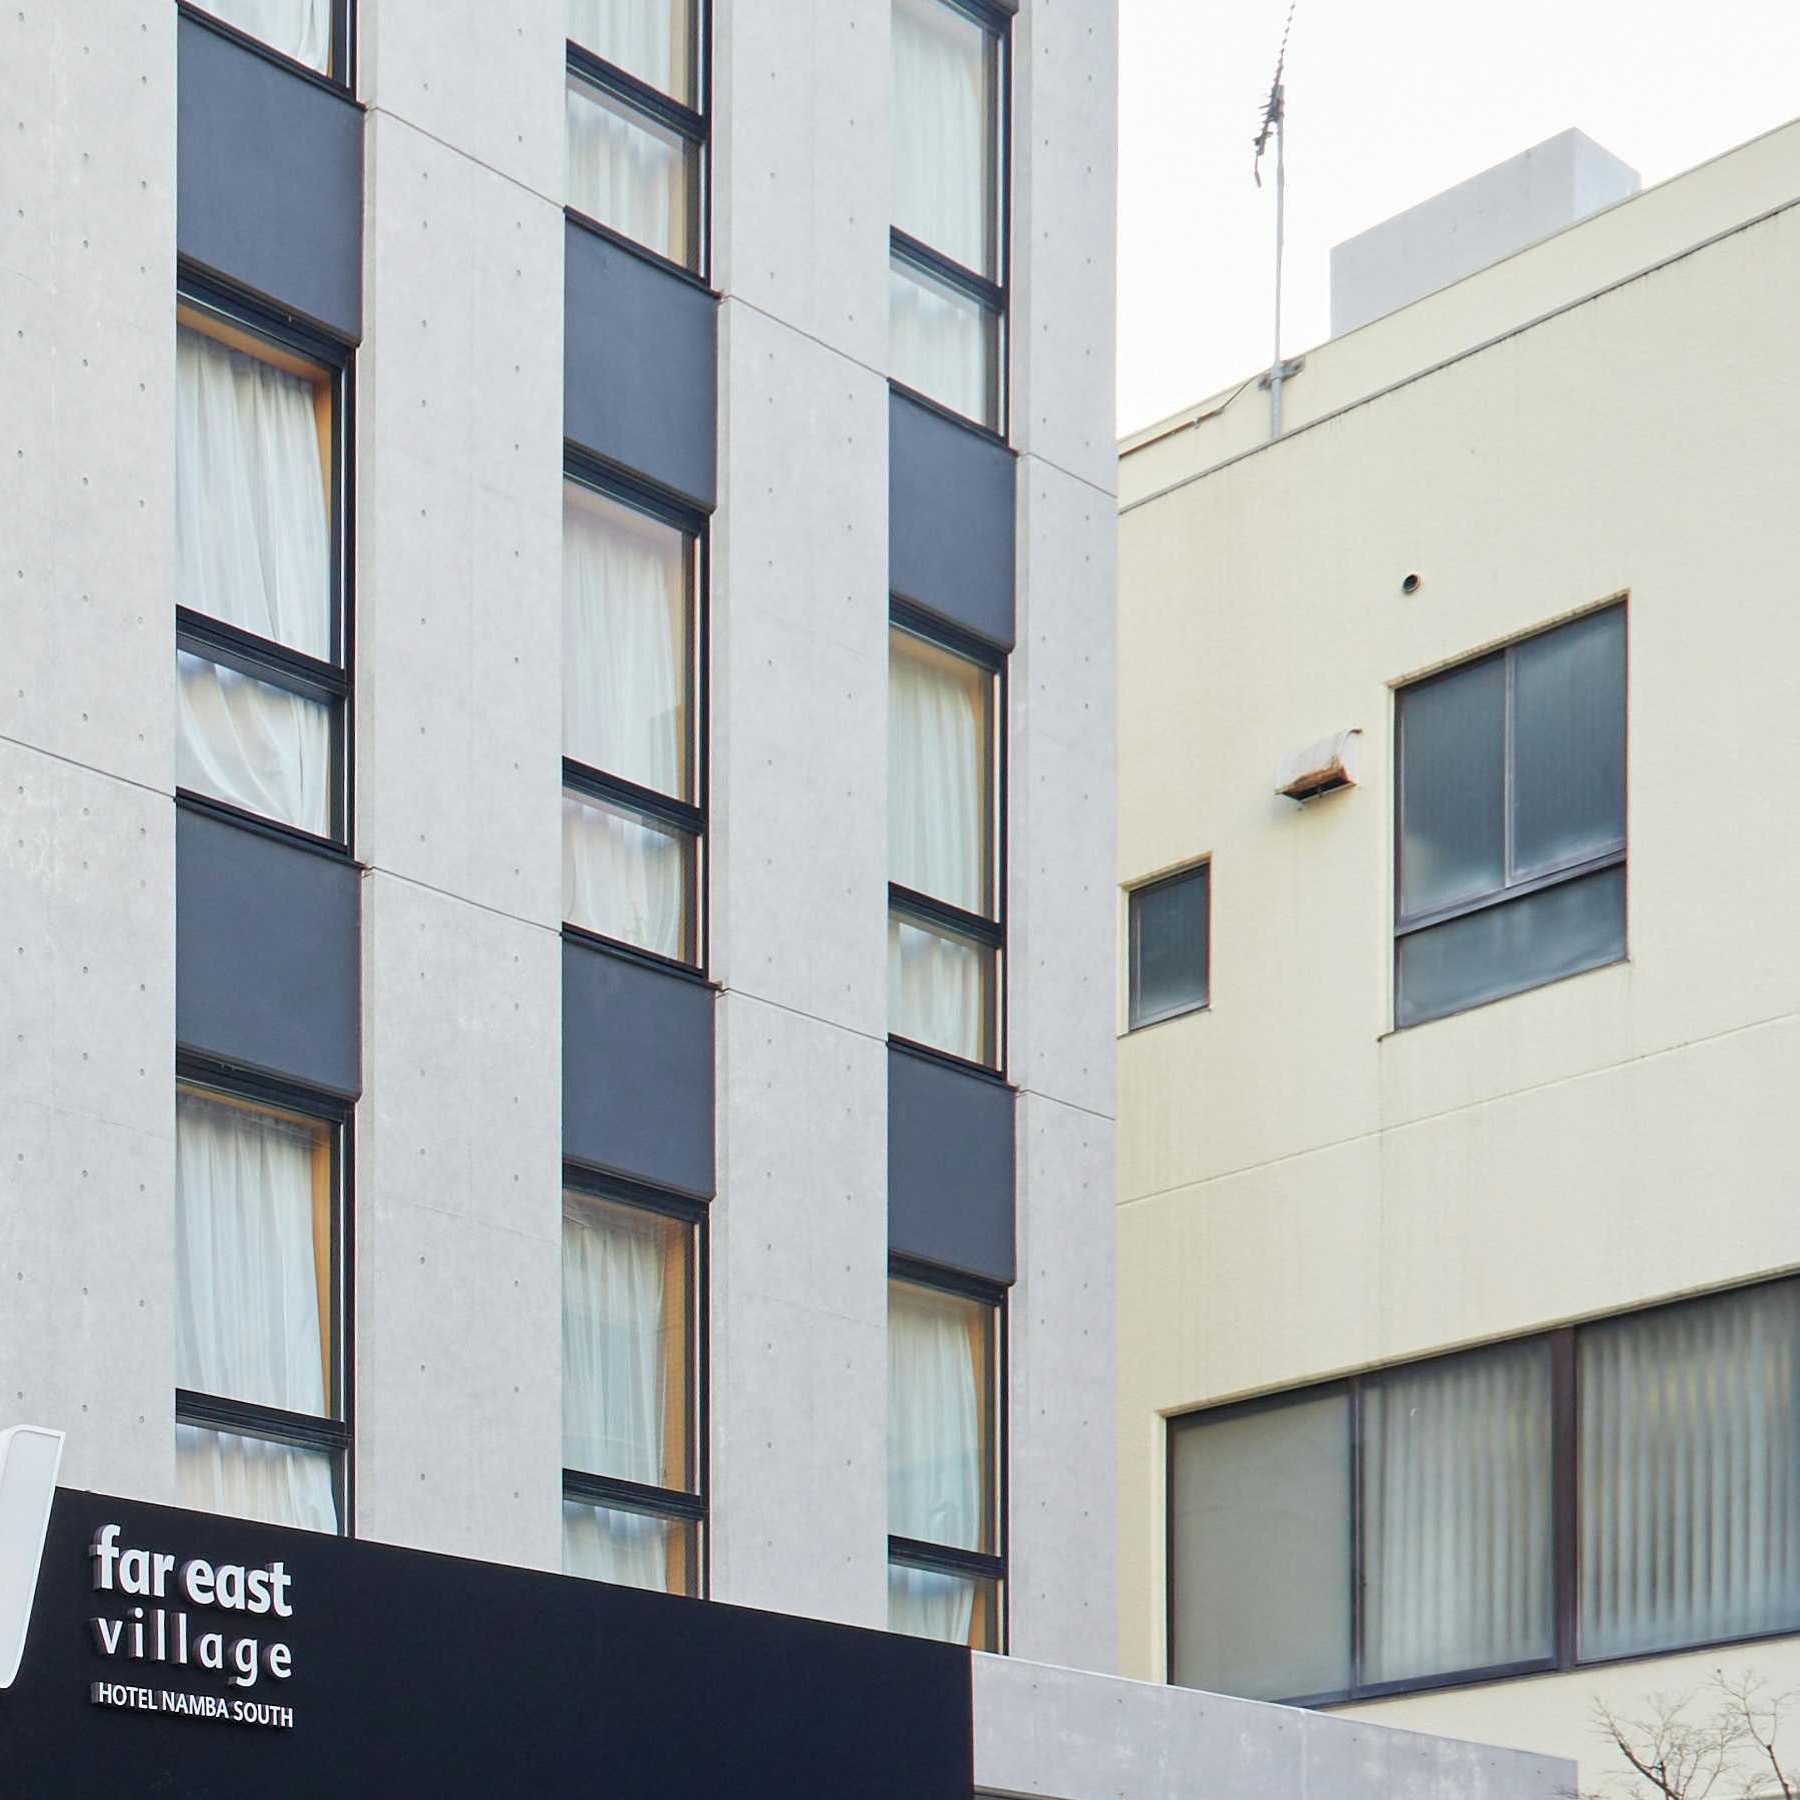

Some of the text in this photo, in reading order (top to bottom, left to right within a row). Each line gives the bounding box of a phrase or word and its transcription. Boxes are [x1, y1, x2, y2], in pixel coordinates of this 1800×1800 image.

[91, 1523, 293, 1618] far east
[93, 1606, 293, 1688] village
[95, 1680, 294, 1729] HOTEL NAMBA SOUTH
